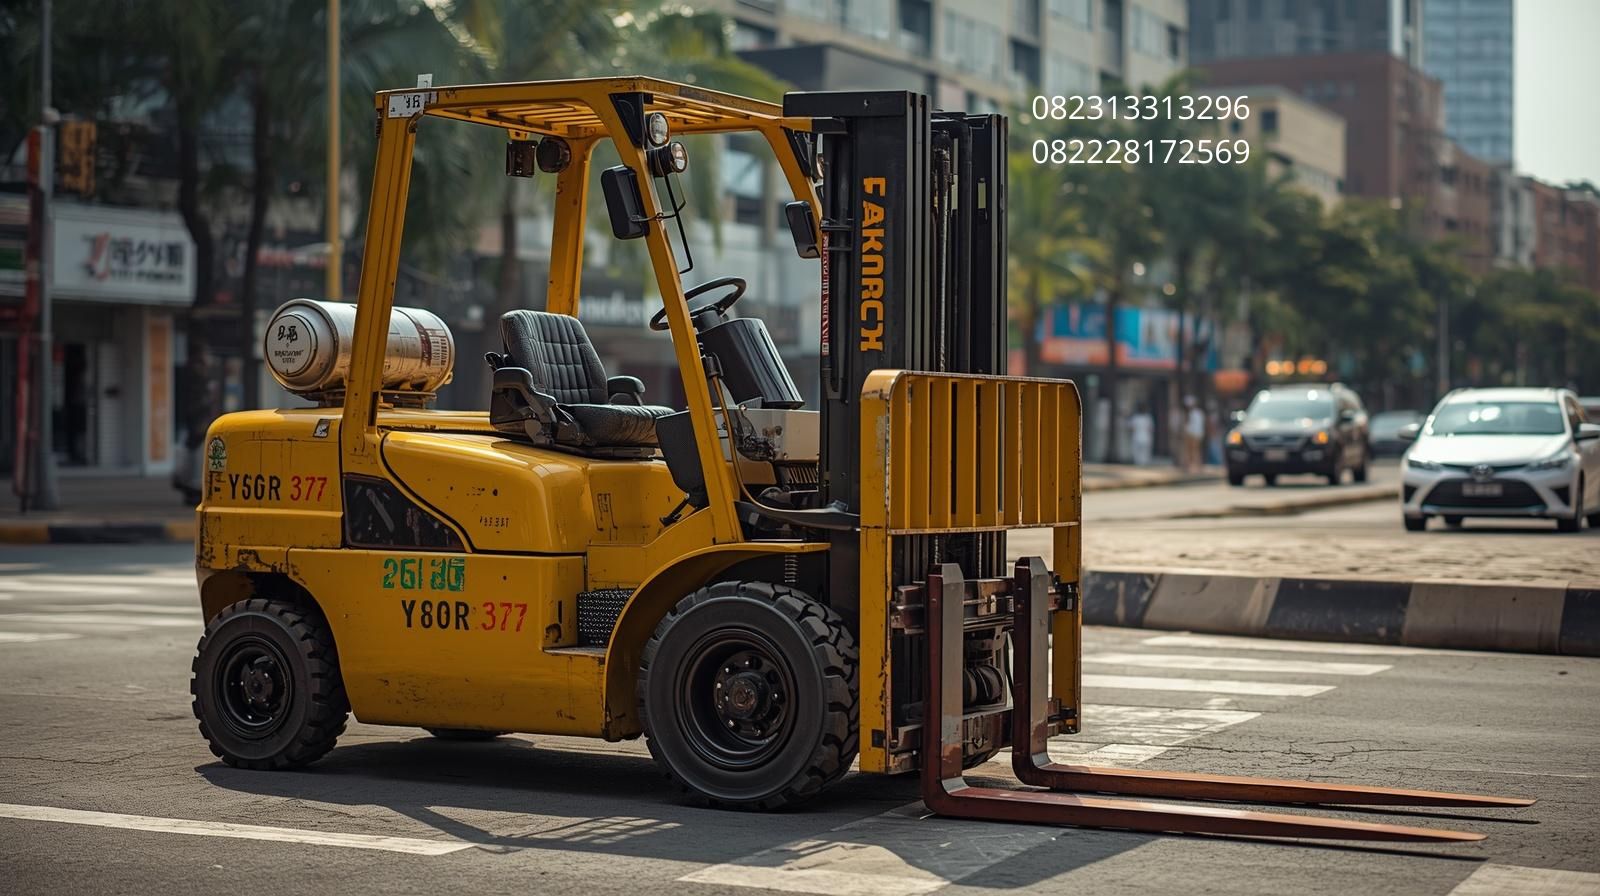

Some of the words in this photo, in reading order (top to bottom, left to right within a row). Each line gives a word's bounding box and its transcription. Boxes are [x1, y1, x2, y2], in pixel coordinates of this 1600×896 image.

[290, 475, 328, 502] 377
[401, 599, 470, 631] Y80R
[481, 601, 528, 632] 377
